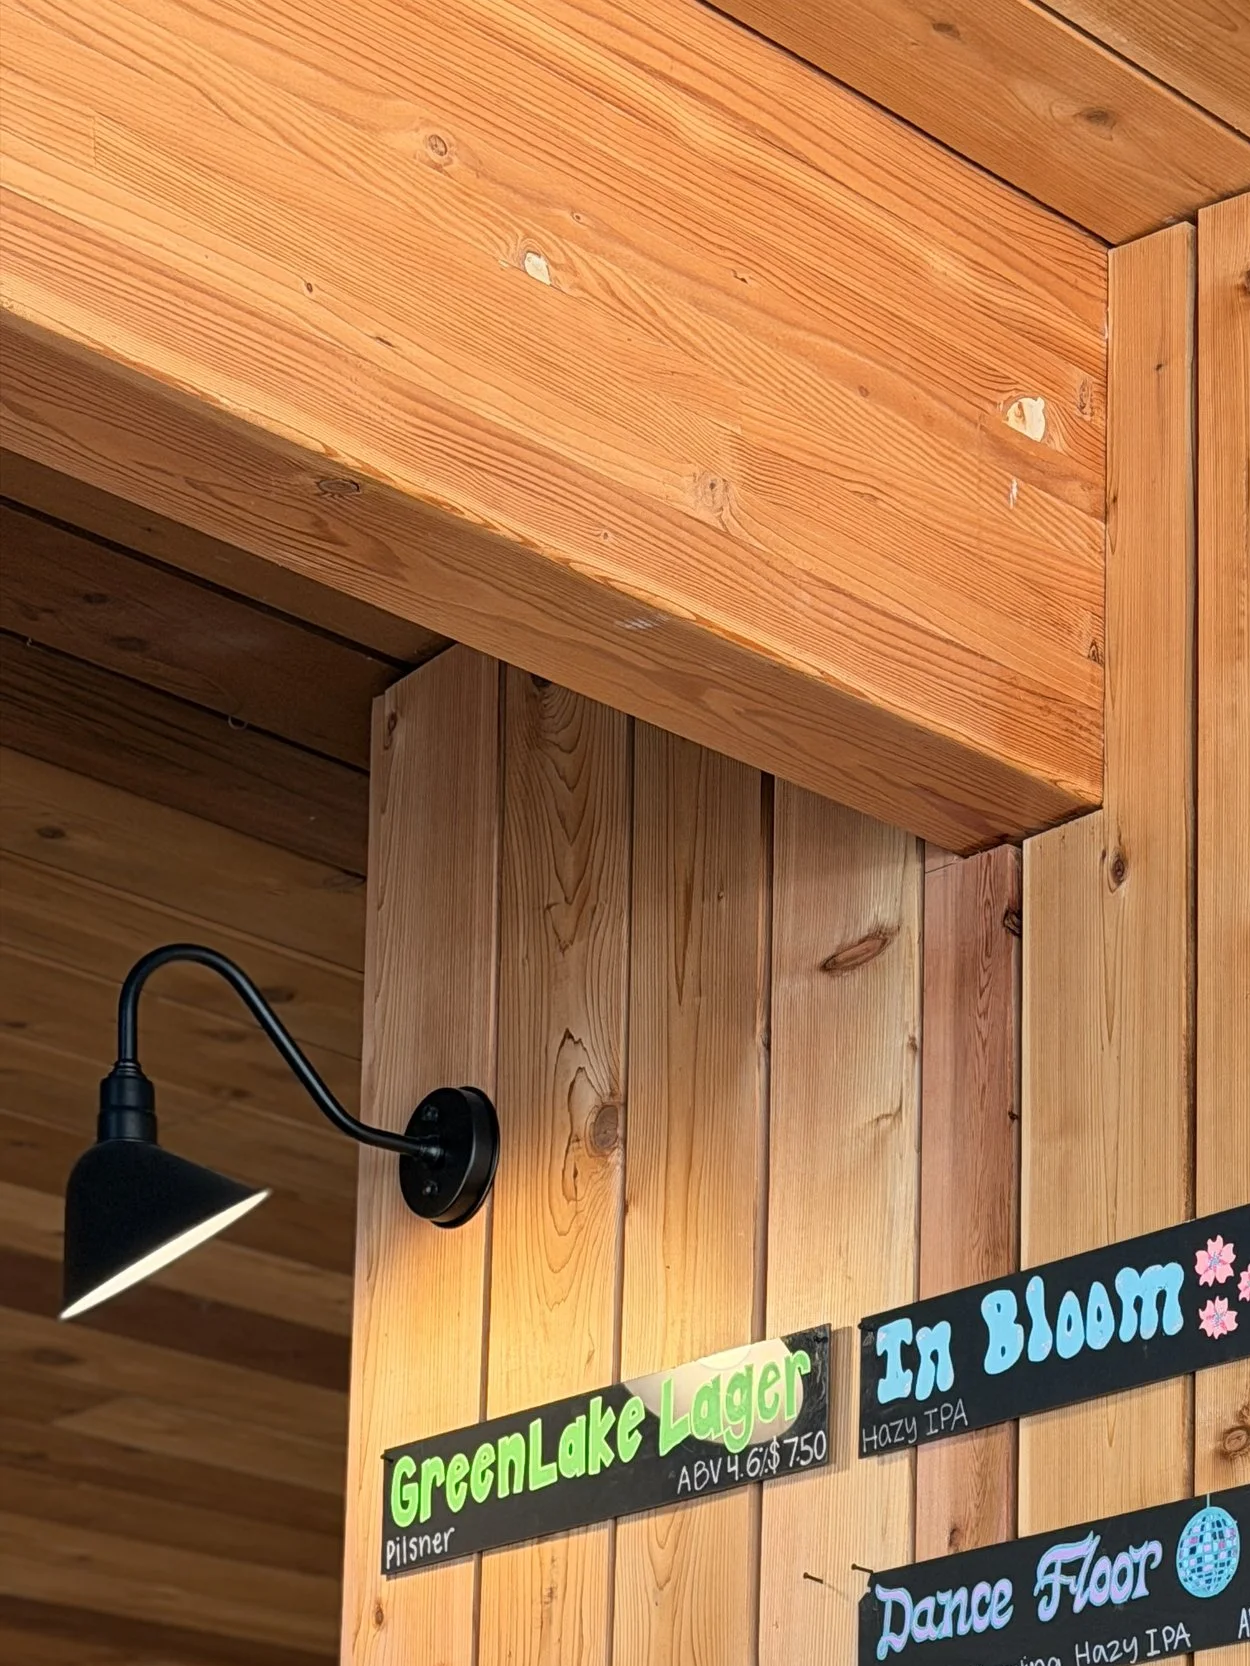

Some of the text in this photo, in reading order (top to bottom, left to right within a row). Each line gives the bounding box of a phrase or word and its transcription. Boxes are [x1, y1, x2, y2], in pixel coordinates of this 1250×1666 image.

[877, 1262, 1185, 1404] In Bloom
[390, 1350, 811, 1527] GreenLake Lager
[862, 1398, 968, 1453] Hazy IPA
[677, 1458, 722, 1494] ABV
[385, 1527, 456, 1570] Pilsner
[875, 1530, 1163, 1661] Dance Floor
[1146, 1622, 1192, 1657] IPA
